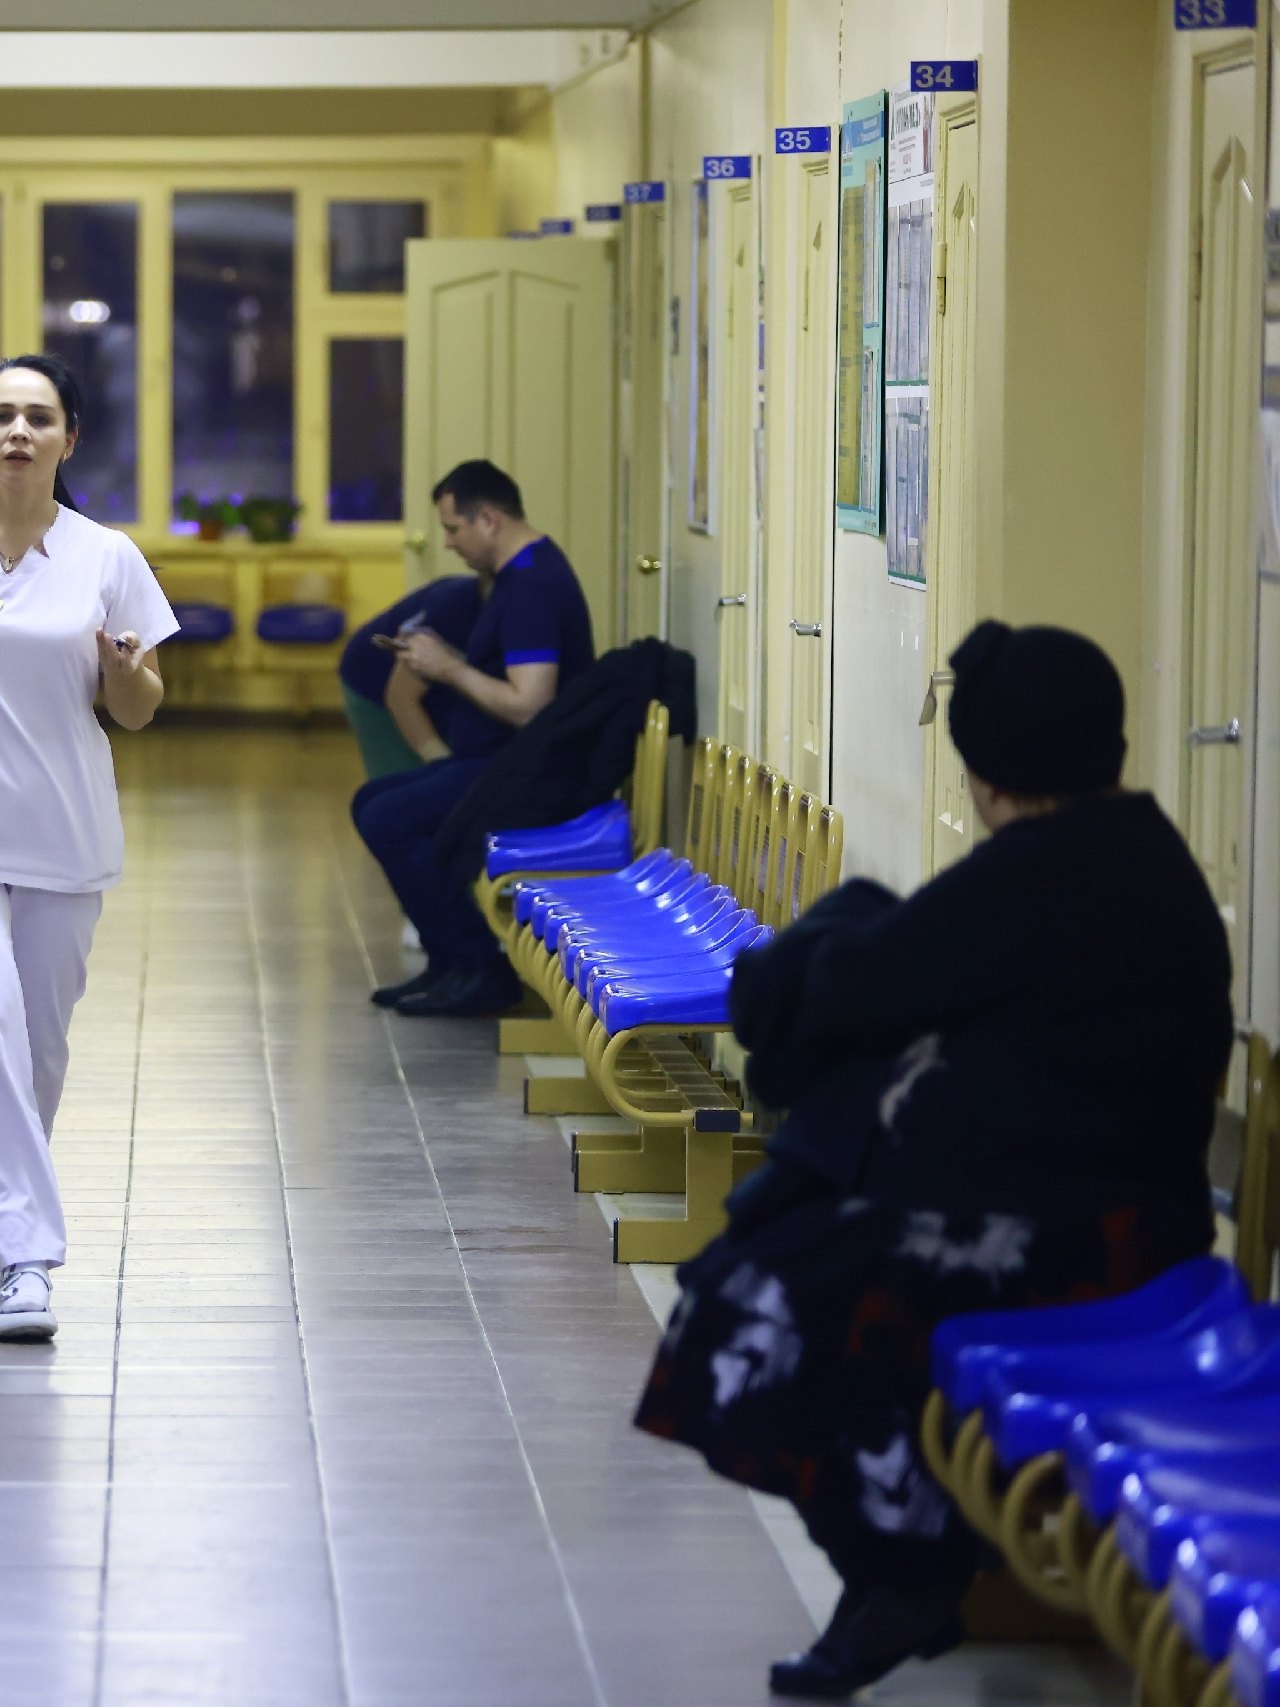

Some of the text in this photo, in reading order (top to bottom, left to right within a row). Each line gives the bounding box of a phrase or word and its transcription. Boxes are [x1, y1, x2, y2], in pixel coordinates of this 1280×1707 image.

[915, 64, 955, 88] 34
[778, 130, 811, 150] 35
[706, 159, 735, 177] 36
[627, 185, 652, 201] 37
